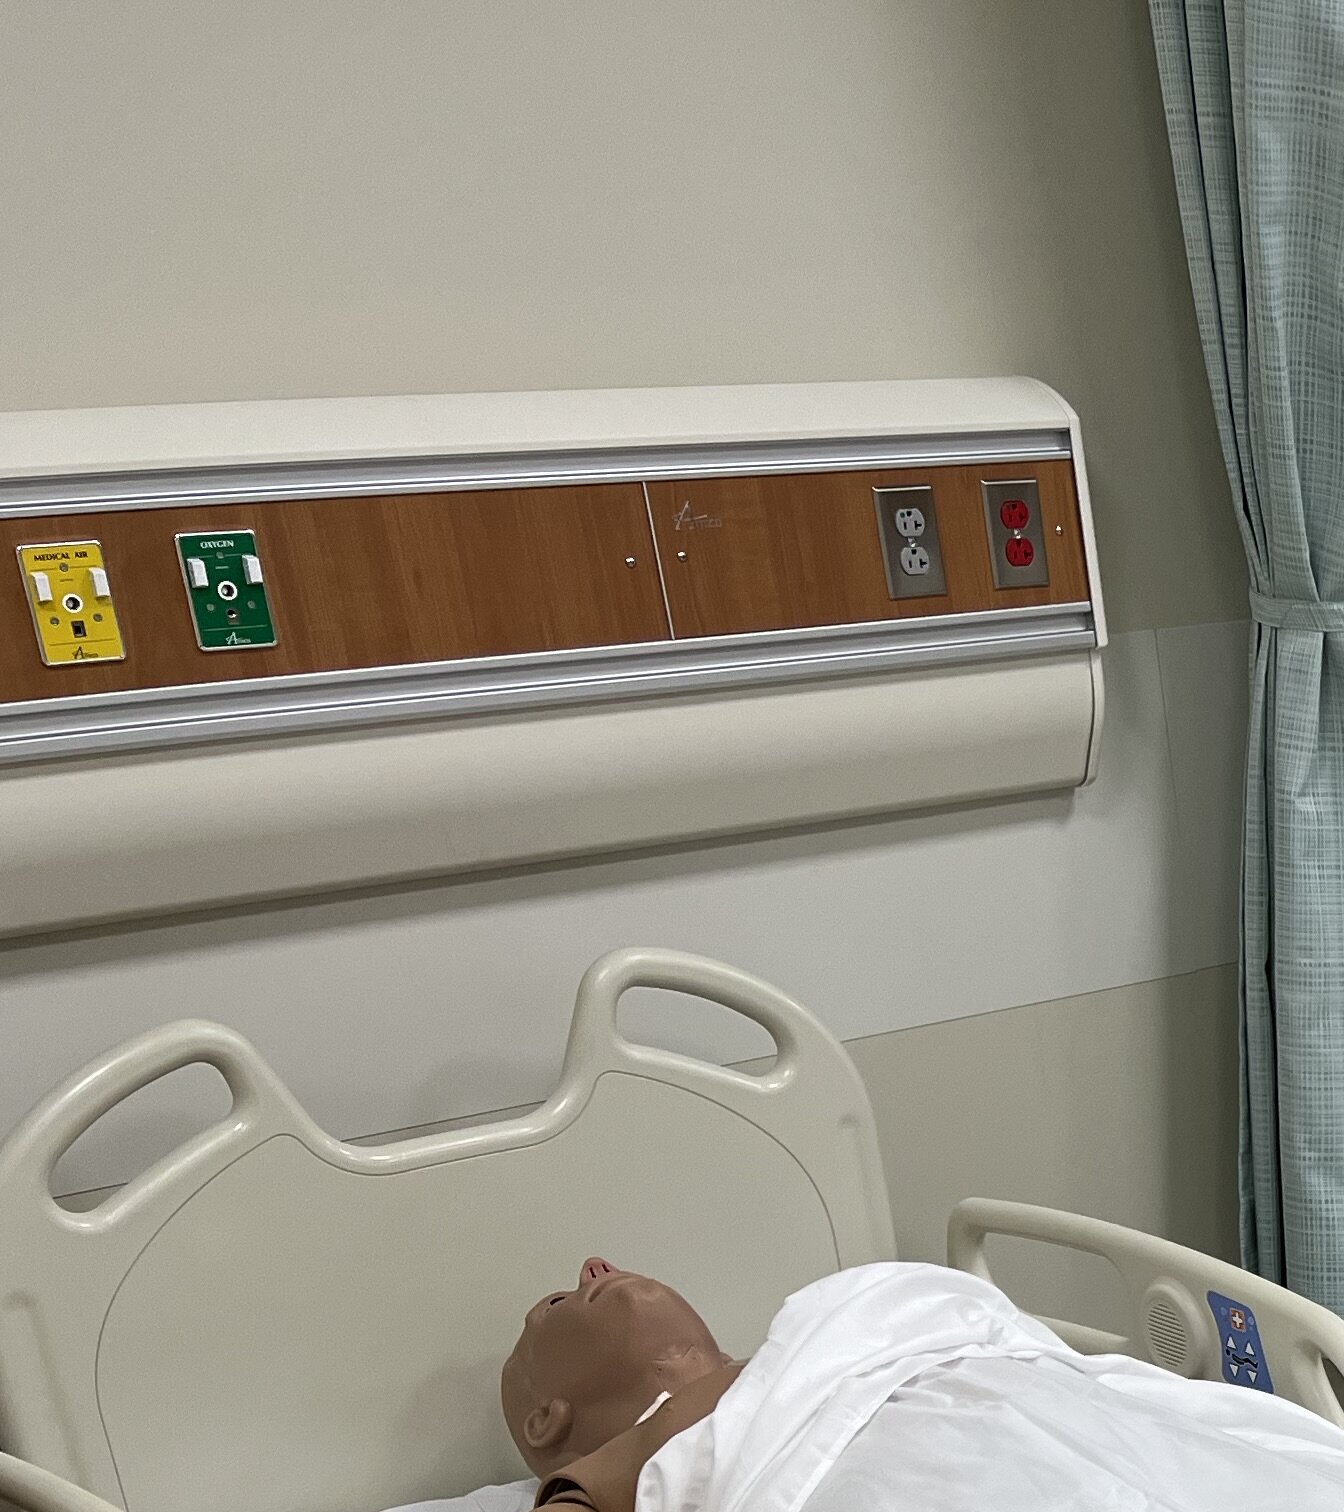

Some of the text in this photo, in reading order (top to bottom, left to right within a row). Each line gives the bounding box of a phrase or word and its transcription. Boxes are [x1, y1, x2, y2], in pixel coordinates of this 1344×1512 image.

[200, 540, 235, 549] OXYGEN
[34, 551, 88, 561] MEDICAL AIR
